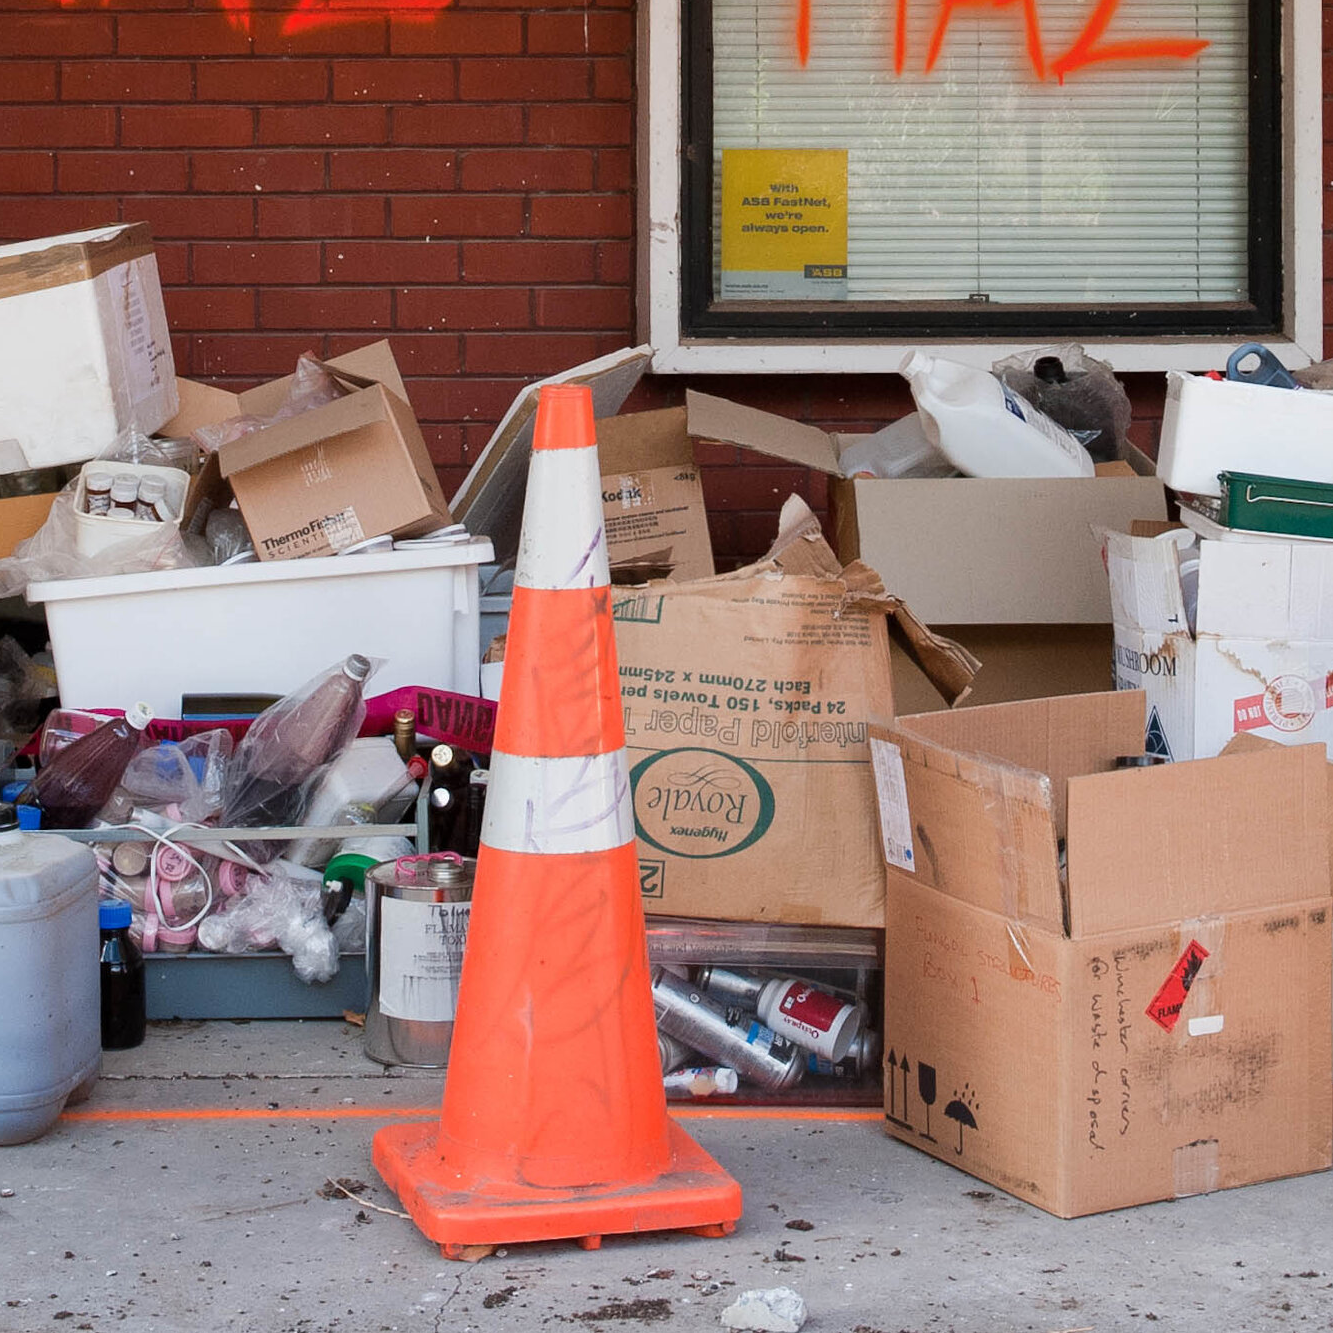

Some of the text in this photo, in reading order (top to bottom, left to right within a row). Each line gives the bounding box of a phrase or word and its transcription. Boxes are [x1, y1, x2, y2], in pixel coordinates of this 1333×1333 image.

[770, 184, 799, 193] With
[741, 197, 831, 208] ASB FastNet,
[765, 212, 803, 220] we're
[741, 223, 829, 234] always open.
[811, 268, 843, 277] ASB
[268, 530, 327, 559] SCIENTI
[682, 671, 692, 682] x
[699, 673, 766, 692] 270mm
[773, 680, 811, 695] Each
[653, 688, 720, 709] Towels
[727, 696, 760, 712] 150
[768, 697, 821, 714] Packs,
[826, 700, 846, 715] 24
[1249, 705, 1262, 719] NOT
[644, 706, 741, 746] Paper
[750, 717, 866, 748] nterfold
[646, 783, 748, 824] Royale
[670, 825, 728, 842] Hygenex
[428, 904, 470, 918] Tolu
